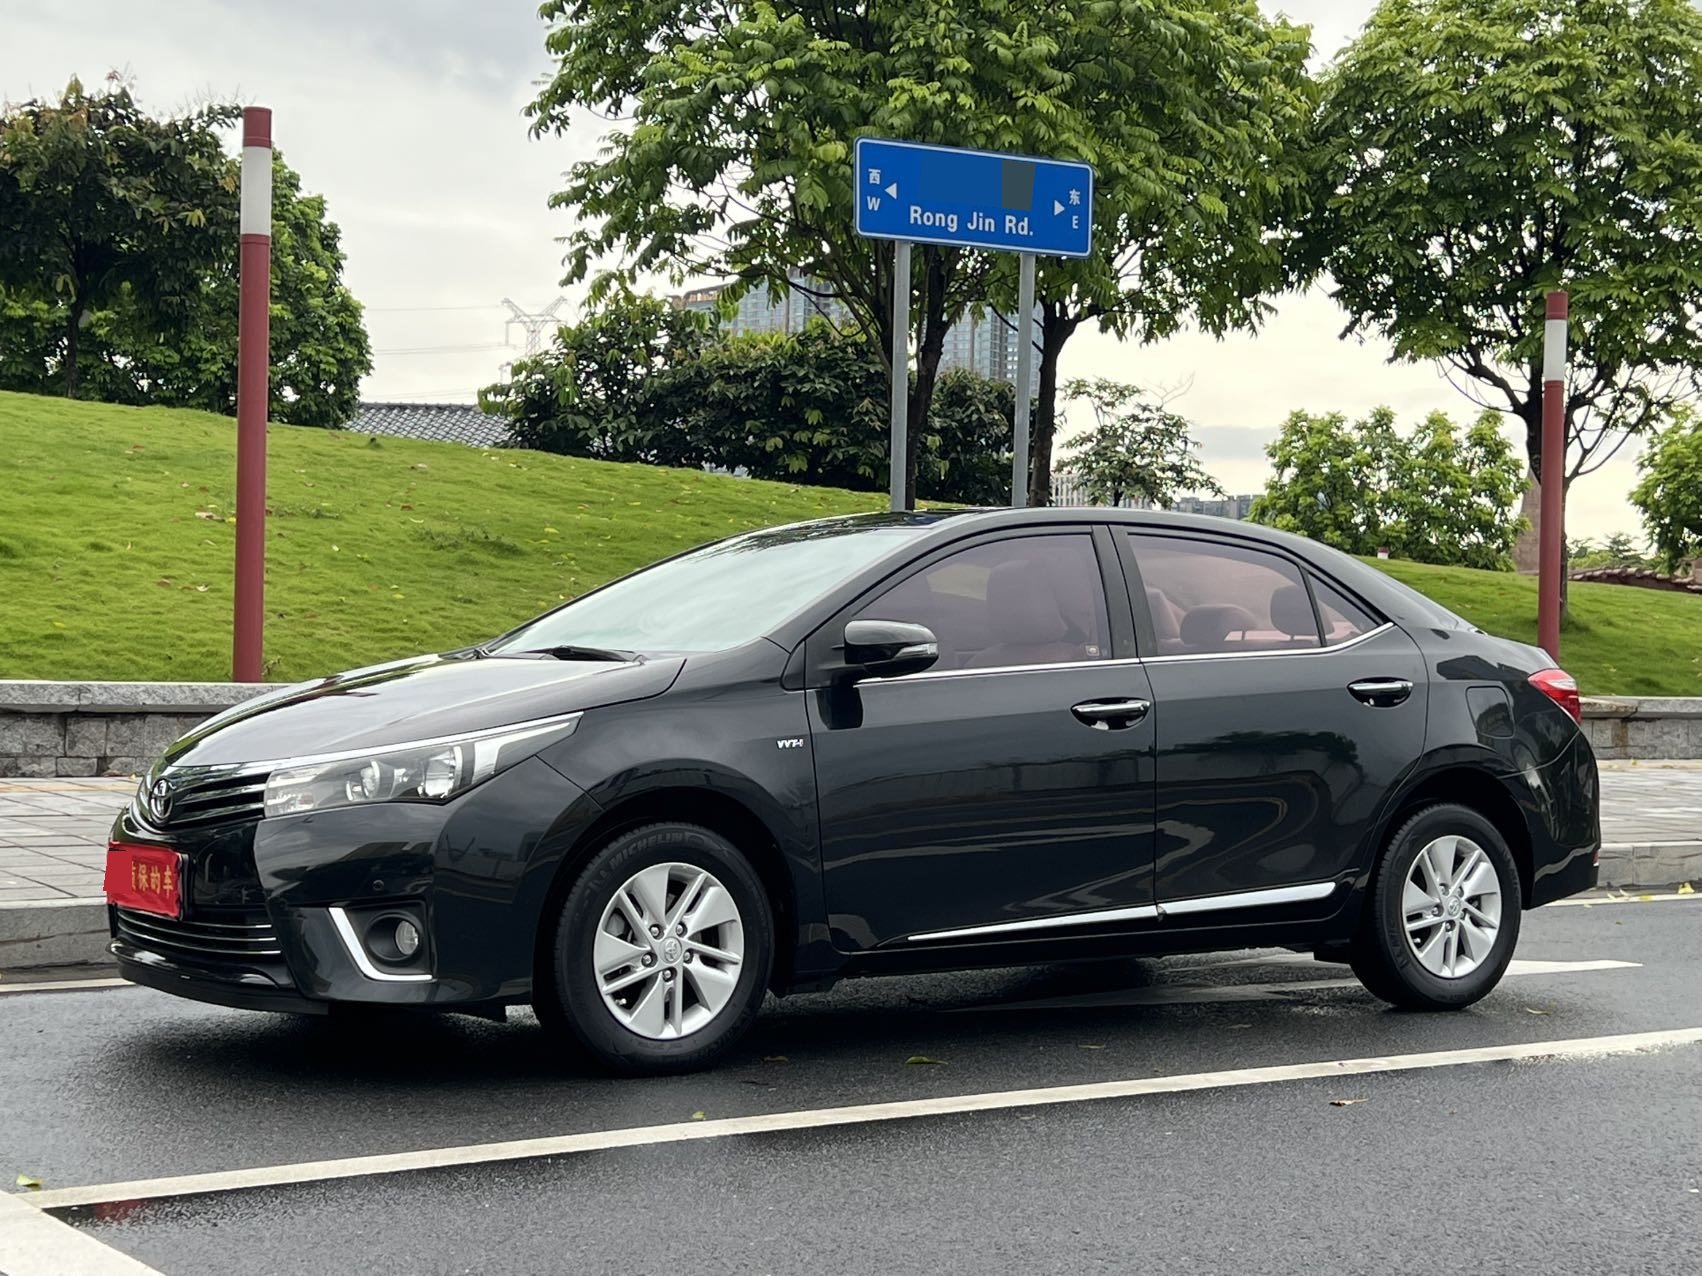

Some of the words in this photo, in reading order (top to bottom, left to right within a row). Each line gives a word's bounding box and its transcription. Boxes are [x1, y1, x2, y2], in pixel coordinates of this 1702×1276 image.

[868, 168, 881, 185] 西
[866, 195, 881, 211] W
[1069, 188, 1080, 205] 东
[909, 205, 958, 232] Rong
[967, 211, 995, 232] Jin
[1004, 214, 1034, 236] Rd.
[1072, 215, 1079, 229] E
